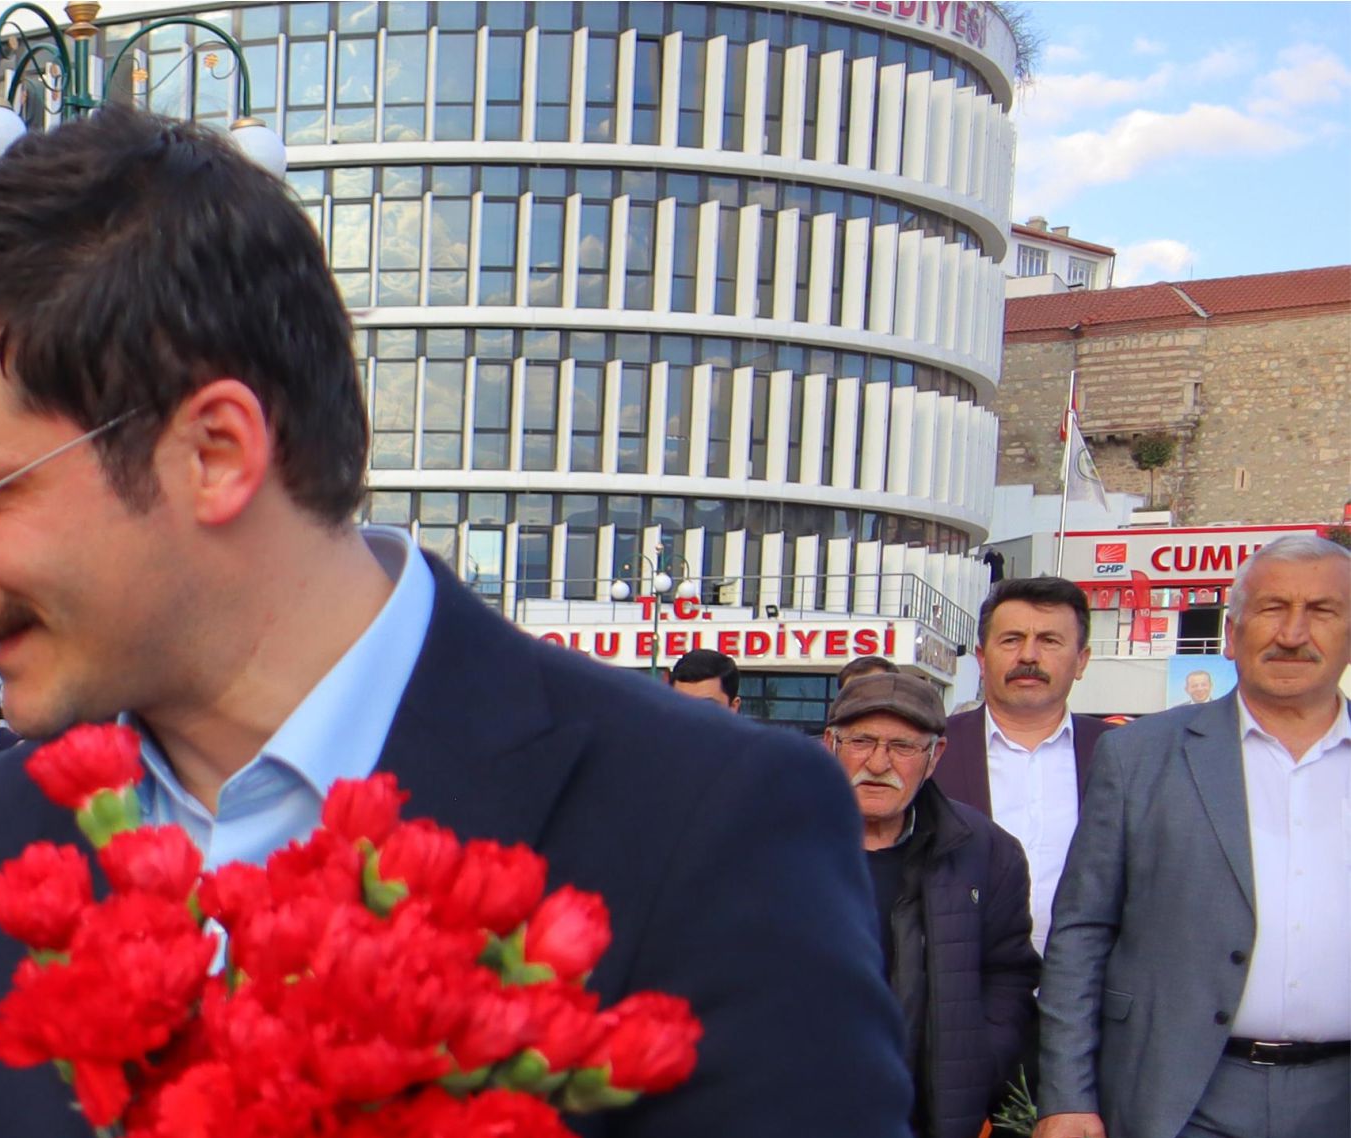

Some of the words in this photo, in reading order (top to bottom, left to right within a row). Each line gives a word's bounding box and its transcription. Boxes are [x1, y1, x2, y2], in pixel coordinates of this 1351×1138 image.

[1097, 564, 1124, 574] CHP
[1151, 544, 1263, 573] CUMH
[636, 595, 713, 621] T.C.
[538, 631, 622, 658] OLU
[636, 623, 896, 659] BELEDİYESİ
